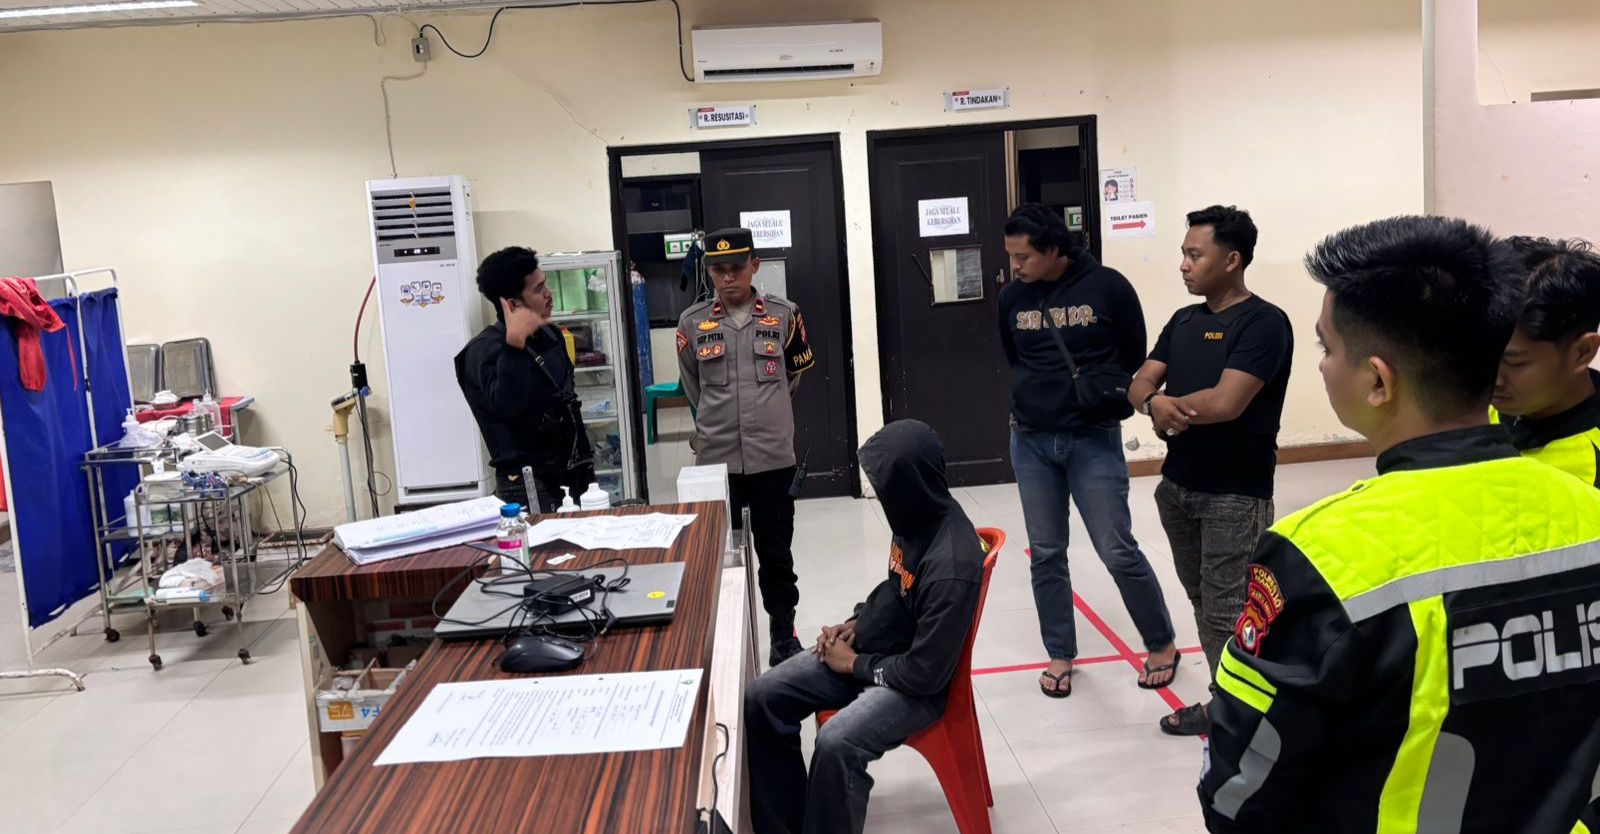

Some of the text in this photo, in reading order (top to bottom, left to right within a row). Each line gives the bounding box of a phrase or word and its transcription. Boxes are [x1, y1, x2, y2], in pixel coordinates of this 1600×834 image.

[967, 95, 998, 105] TINDAKAN
[711, 112, 745, 122] RESUSITASI
[755, 329, 780, 339] POLRI
